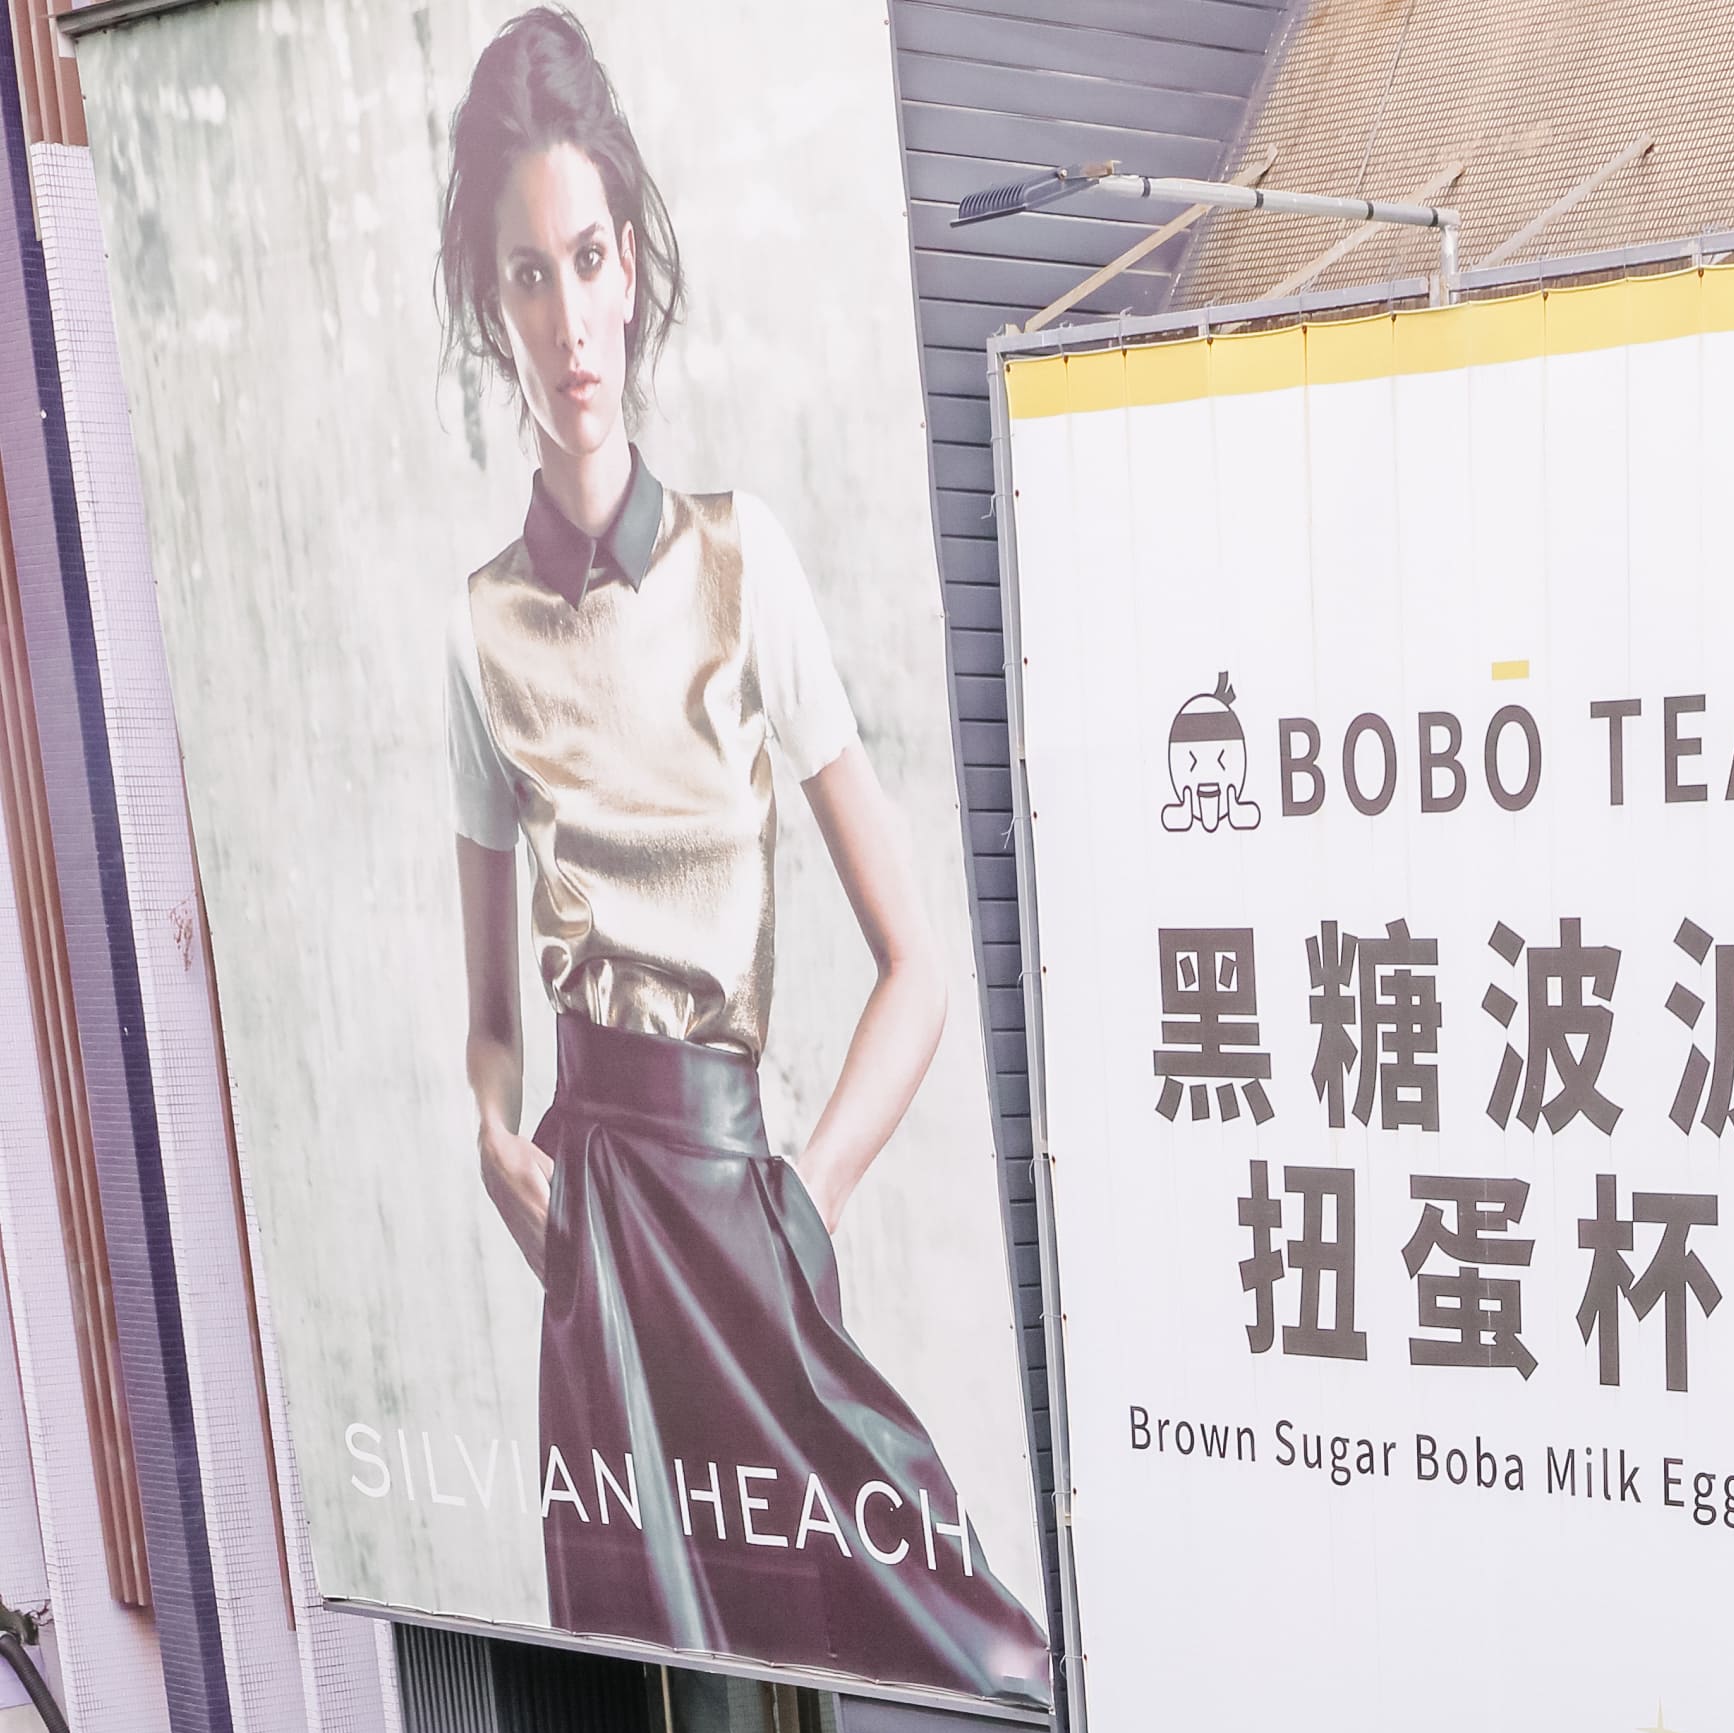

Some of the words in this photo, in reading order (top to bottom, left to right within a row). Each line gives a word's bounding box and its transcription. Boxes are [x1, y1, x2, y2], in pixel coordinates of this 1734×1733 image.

[1237, 1158, 1724, 1394] 扭蛋杯
[344, 1422, 646, 1531] SILVIAN
[673, 1457, 976, 1579] HEACH
[1128, 1405, 1257, 1465] Brown
[1274, 1418, 1397, 1487] Sugar
[1414, 1432, 1525, 1492] Boba
[1545, 1446, 1642, 1506] Milk
